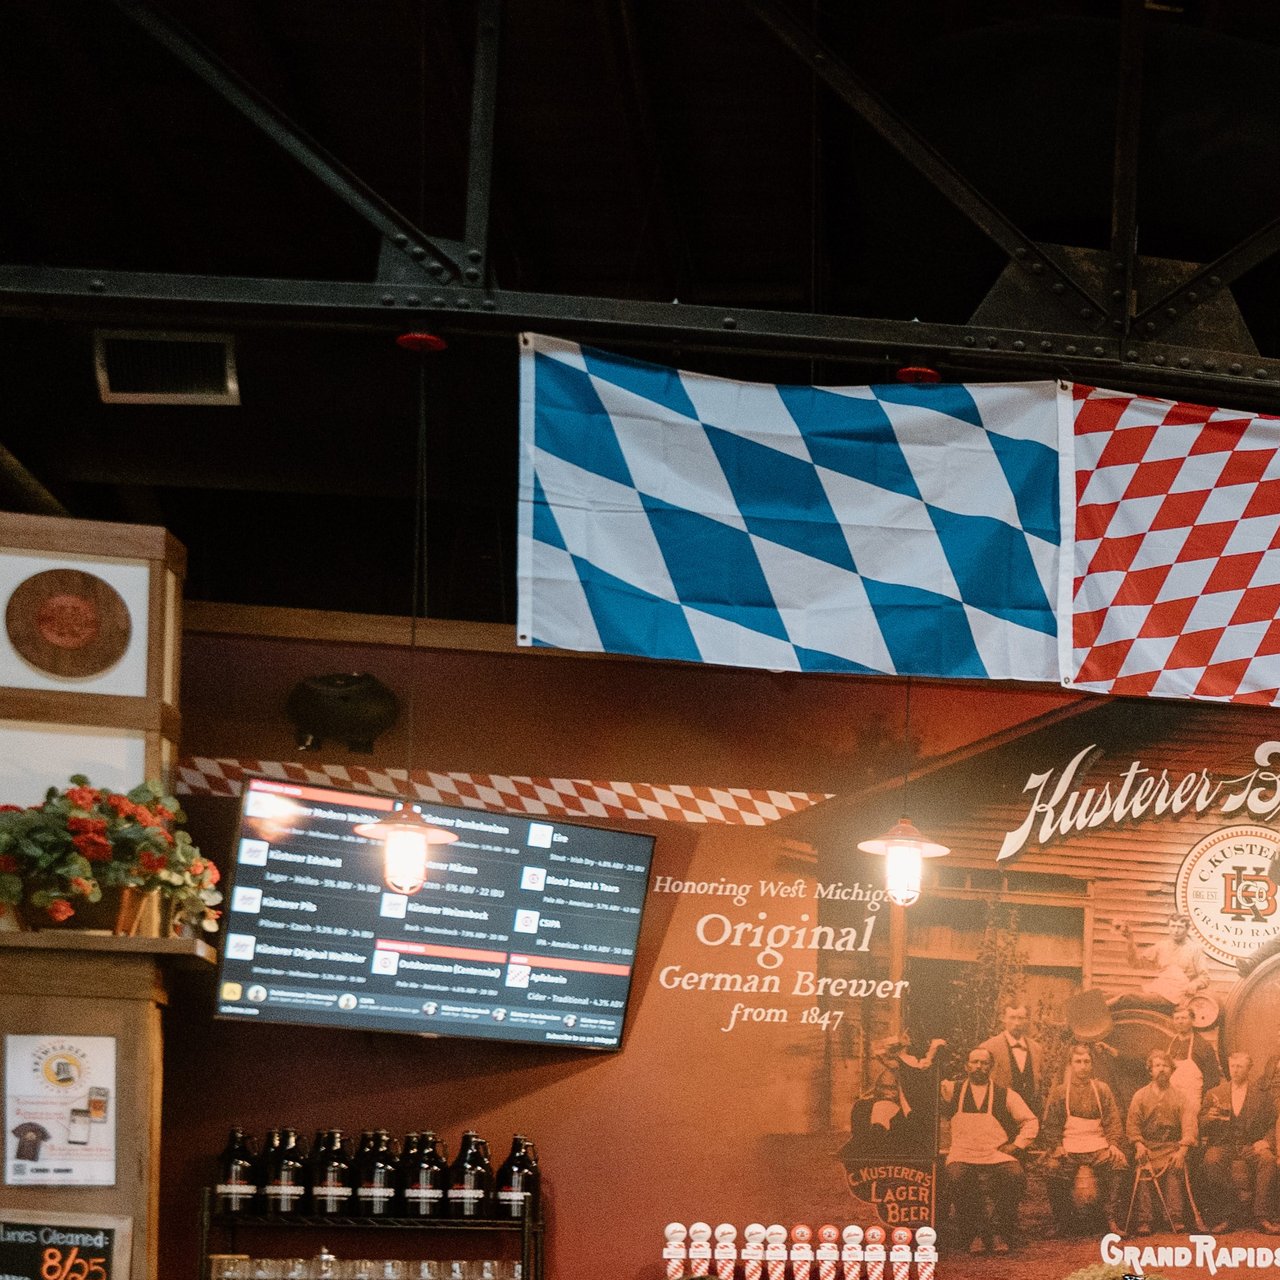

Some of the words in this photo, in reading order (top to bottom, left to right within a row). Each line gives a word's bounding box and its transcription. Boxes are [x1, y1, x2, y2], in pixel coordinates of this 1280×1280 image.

[996, 743, 1222, 862] Kusterer
[654, 876, 752, 907] Honoring
[758, 878, 807, 900] West
[813, 882, 892, 911] Michiga
[1194, 907, 1243, 937] GRAND
[696, 911, 877, 969] Original
[659, 965, 780, 993] German
[792, 970, 909, 999] Brewer
[721, 1003, 788, 1032] from
[800, 1007, 843, 1032] 1847
[870, 1181, 930, 1204] LAGER
[887, 1202, 929, 1223] BEER
[40, 1227, 109, 1248] Cleaned:
[1101, 1232, 1192, 1275] GRAND
